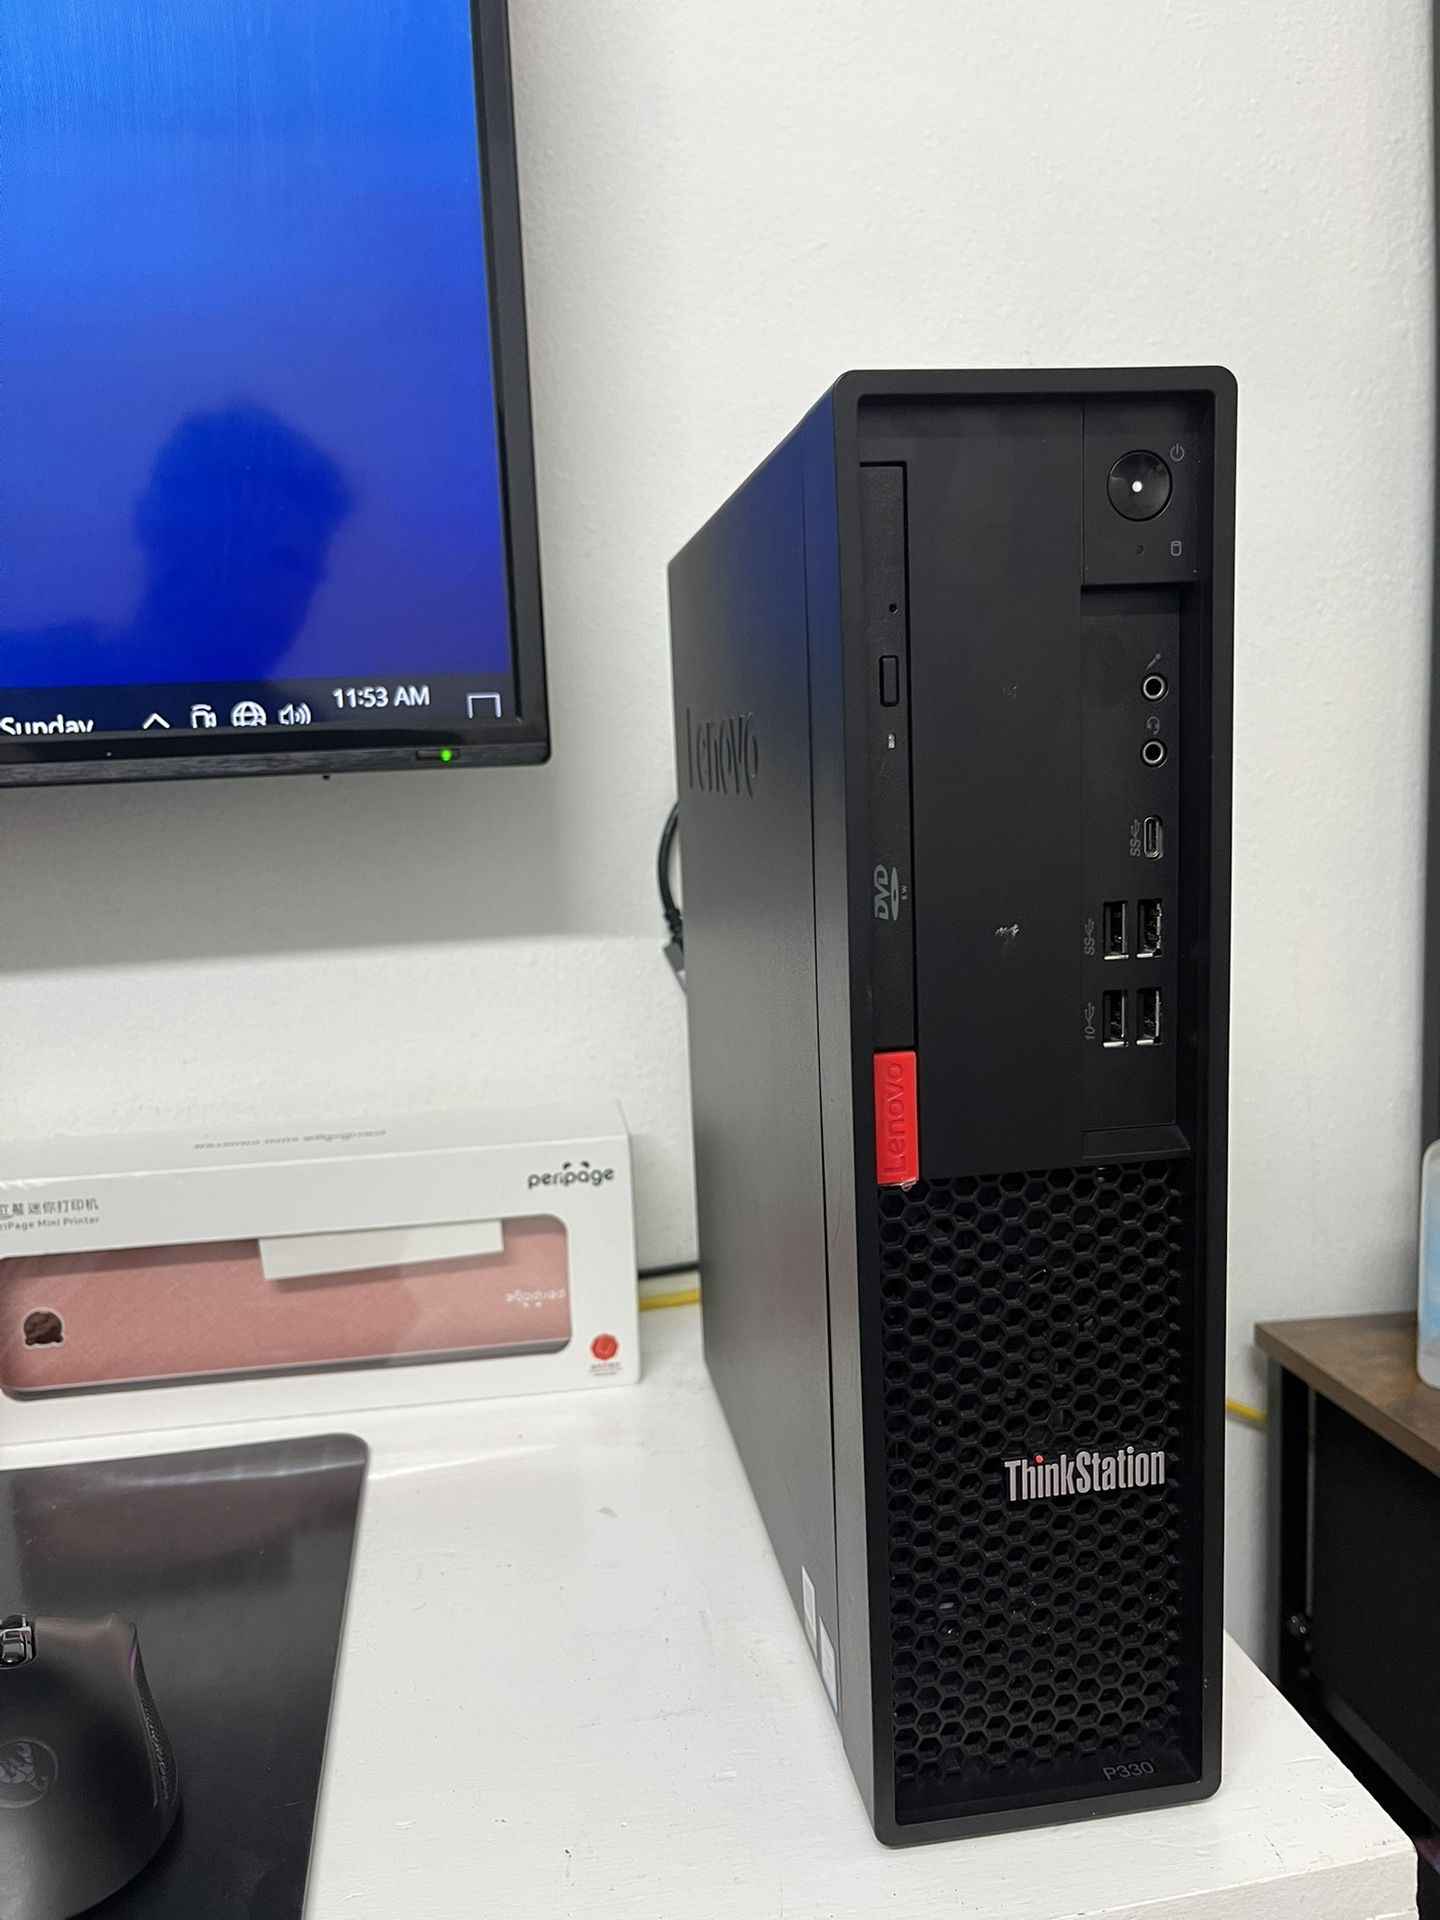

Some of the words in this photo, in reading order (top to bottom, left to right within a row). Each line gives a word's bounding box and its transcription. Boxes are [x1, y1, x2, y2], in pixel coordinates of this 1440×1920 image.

[333, 686, 389, 709] 11:53
[394, 685, 431, 707] AM
[874, 864, 890, 920] DVD
[884, 1063, 906, 1173] Lenovo
[527, 1161, 615, 1190] peripage
[63, 1216, 99, 1227] Printer
[1004, 1446, 1165, 1501] ThinkStation
[1102, 1761, 1154, 1780] P330
